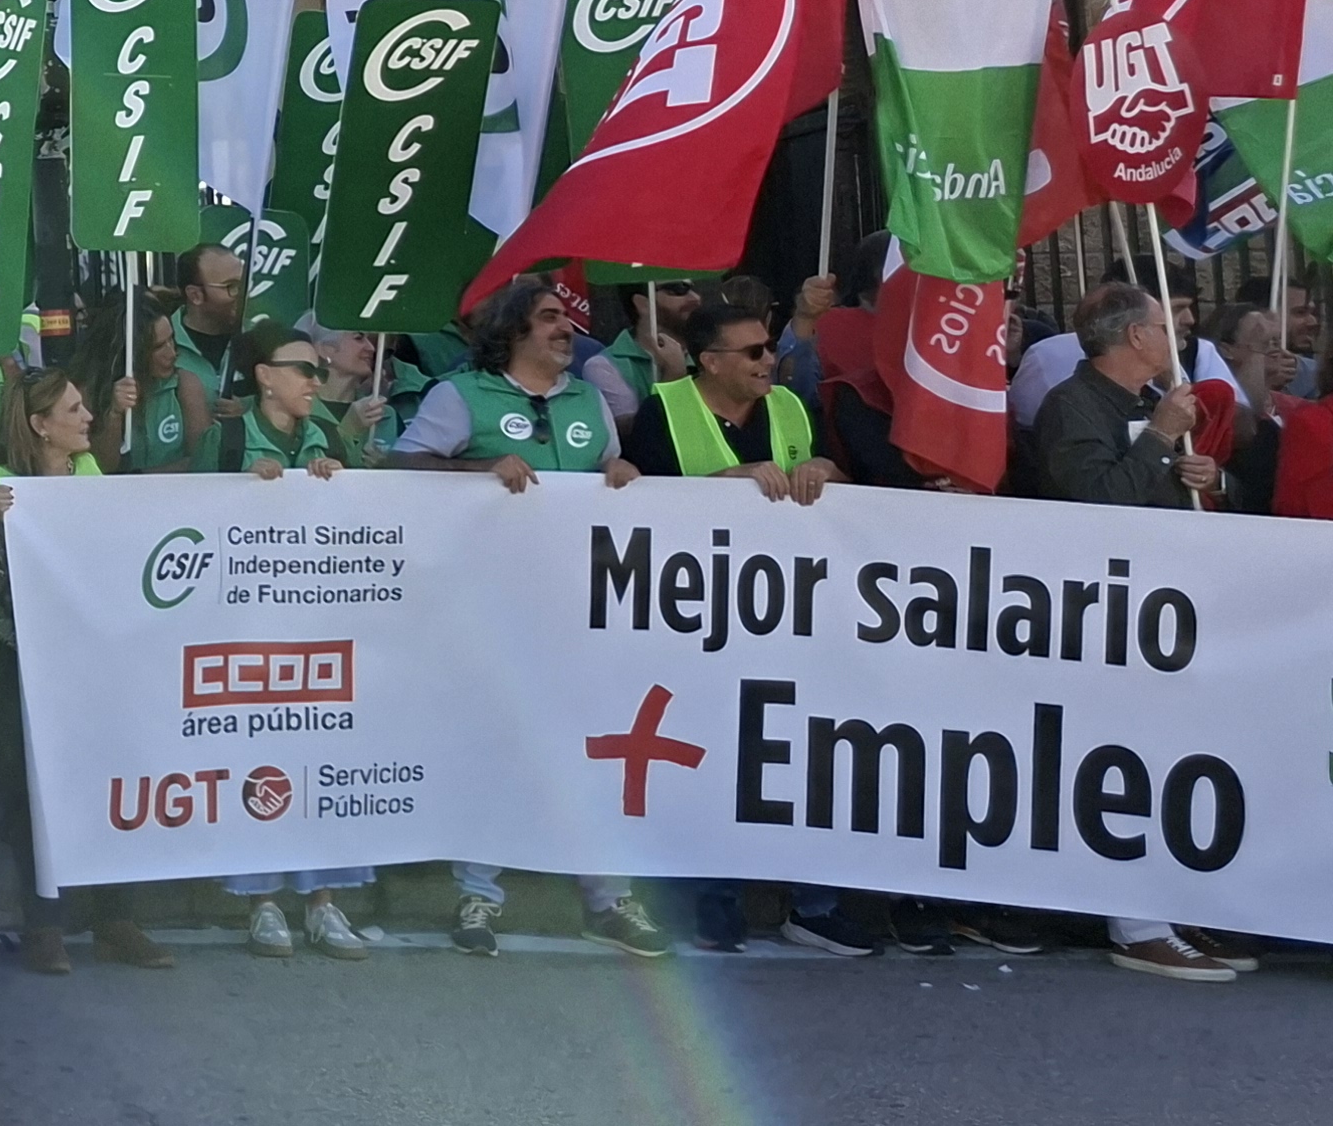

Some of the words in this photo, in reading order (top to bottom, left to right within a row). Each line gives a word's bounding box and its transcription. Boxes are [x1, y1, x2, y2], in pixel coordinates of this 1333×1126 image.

[387, 37, 480, 70] CSIF
[1084, 22, 1181, 111] UGT
[114, 26, 155, 237] CSIF
[1113, 146, 1183, 181] Andalucía
[360, 114, 435, 318] CSIF
[156, 552, 214, 581] CSIF
[227, 526, 306, 546] Central
[314, 524, 404, 546] Sindical
[228, 555, 385, 578] Independiente
[390, 559, 406, 577] y
[226, 584, 251, 605] de
[257, 583, 403, 605] Funcionarios
[589, 525, 828, 653] Mejor
[856, 546, 1197, 673] salario
[193, 652, 343, 695] CCOO
[181, 711, 239, 738] área
[247, 706, 355, 738] pública
[107, 768, 231, 832] UGT
[318, 763, 425, 787] Servicios
[735, 679, 1247, 872] Empleo
[317, 794, 415, 820] Públicos
